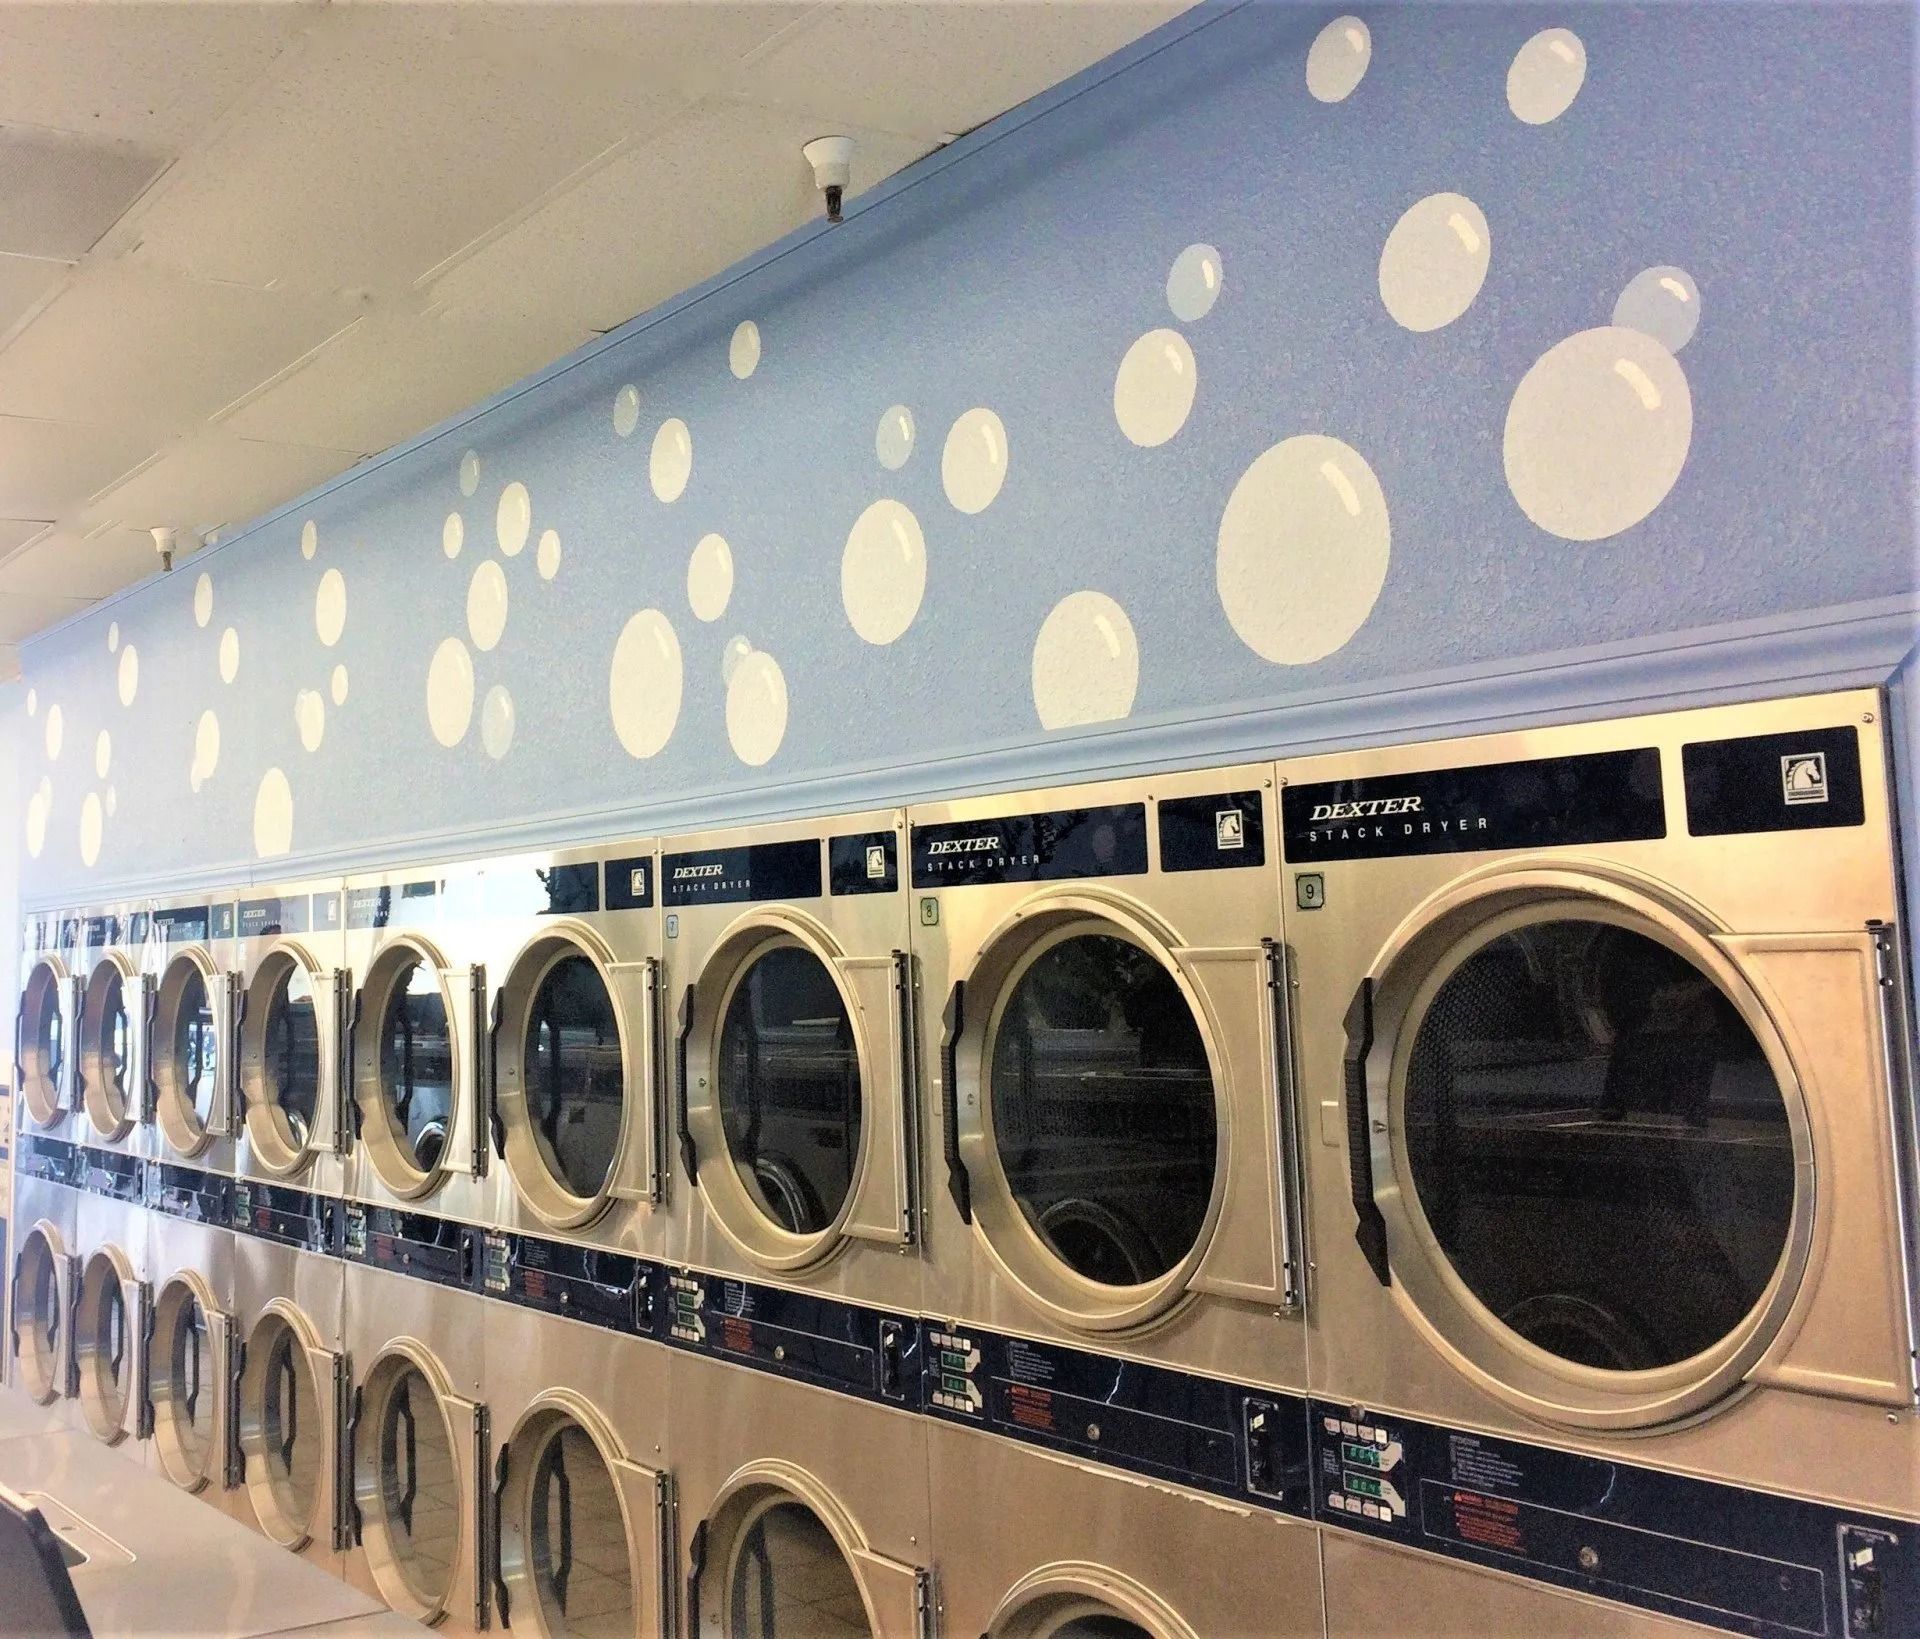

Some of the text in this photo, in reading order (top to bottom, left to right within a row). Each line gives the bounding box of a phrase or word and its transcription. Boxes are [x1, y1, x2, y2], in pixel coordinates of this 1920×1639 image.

[1309, 796, 1423, 821] DEXTER
[1309, 818, 1487, 842] STACK DRYER
[927, 836, 1000, 855] DEXTER
[927, 854, 1040, 872] STACK DRYER
[673, 864, 723, 879] DEXTER
[672, 879, 751, 893] STACK DRYER
[1306, 884, 1315, 899] 9
[926, 905, 933, 918] 8
